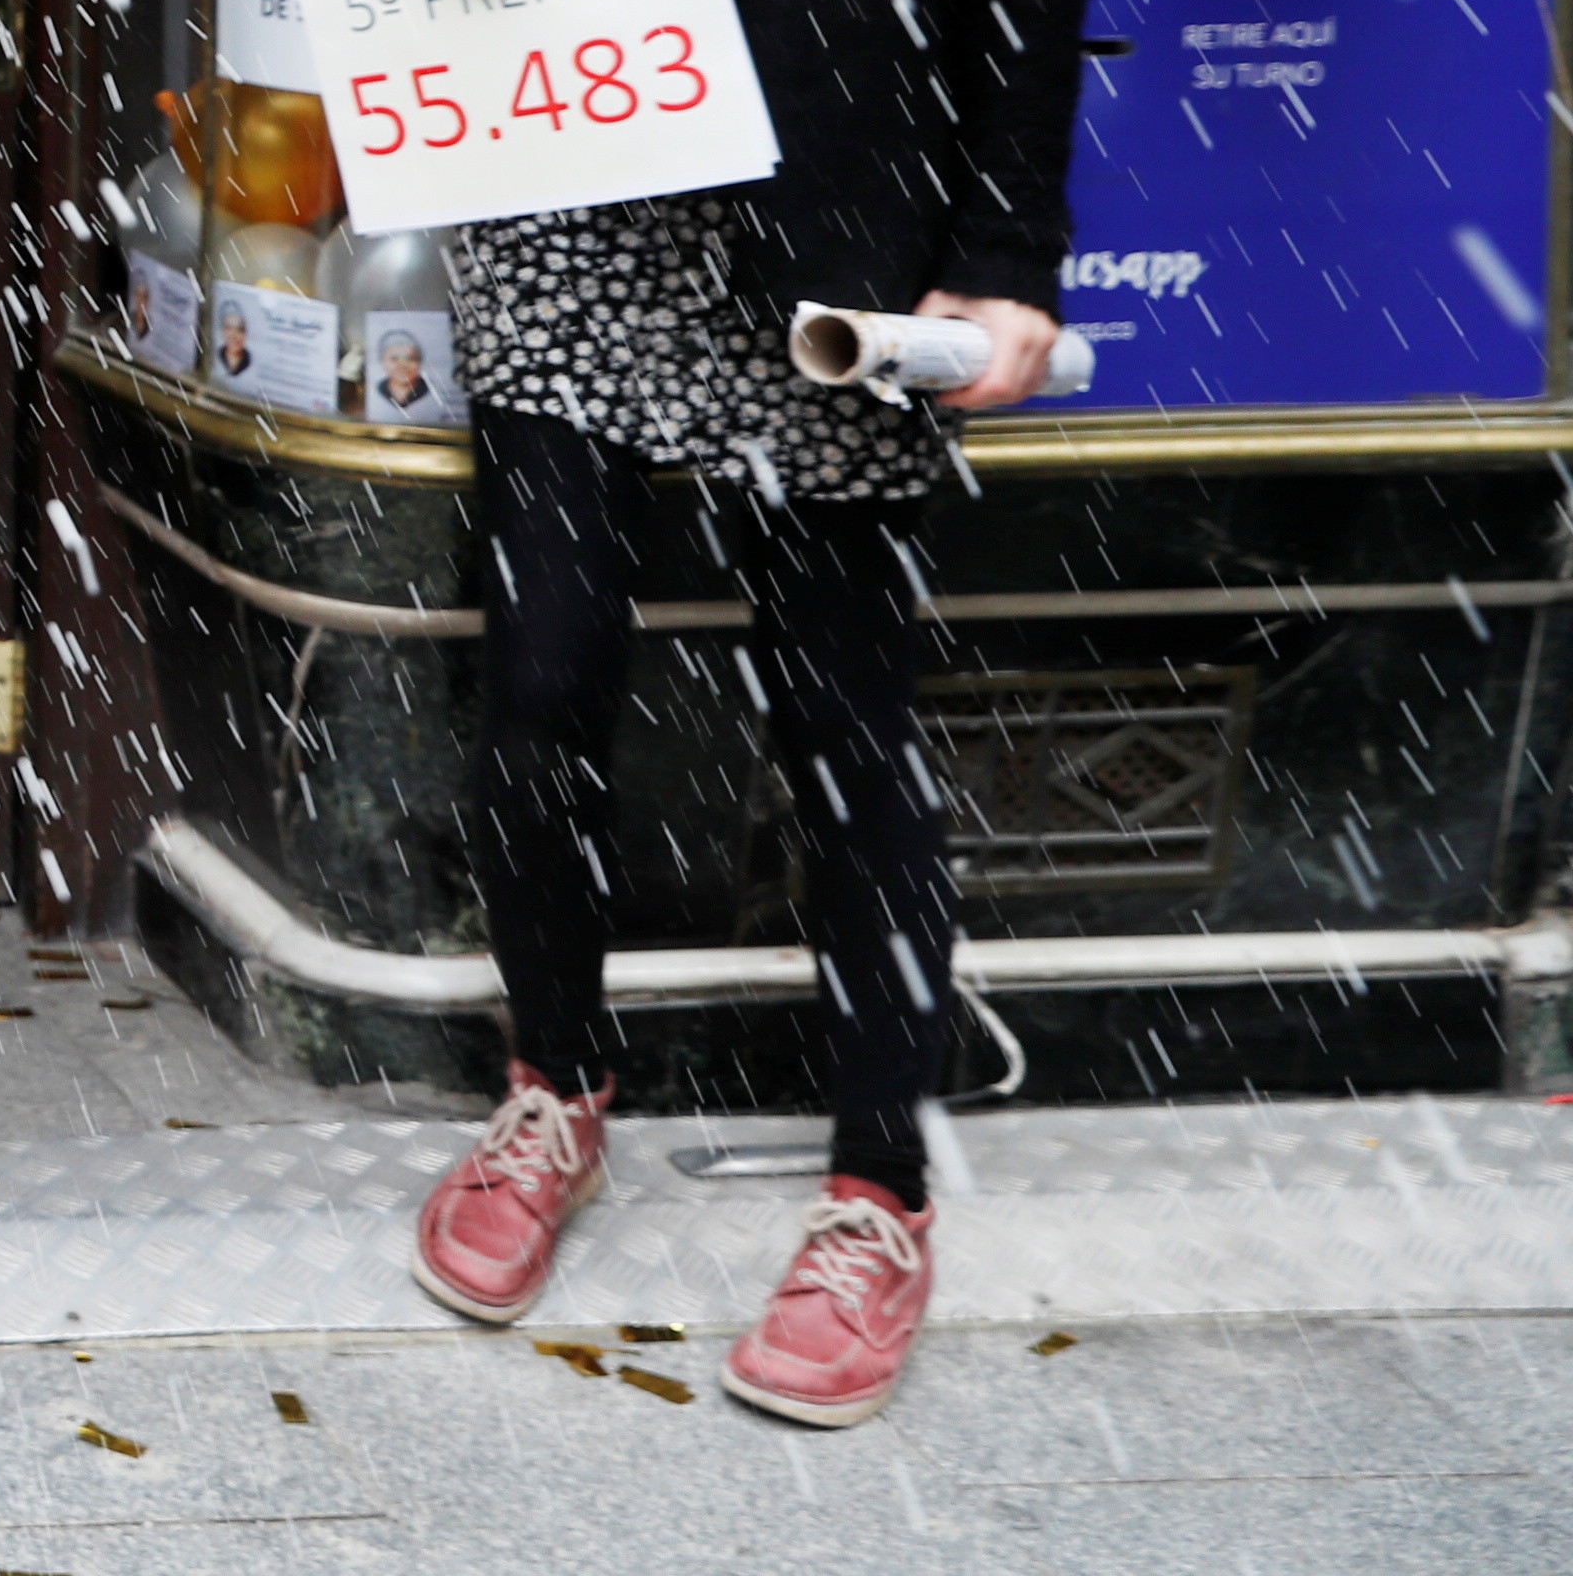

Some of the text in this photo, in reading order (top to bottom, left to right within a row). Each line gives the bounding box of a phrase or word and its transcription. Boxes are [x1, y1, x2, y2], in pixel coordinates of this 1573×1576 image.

[1181, 14, 1338, 50] RETIRE AQUÍ
[349, 24, 710, 156] 55.483
[1191, 59, 1326, 90] SU TURNO
